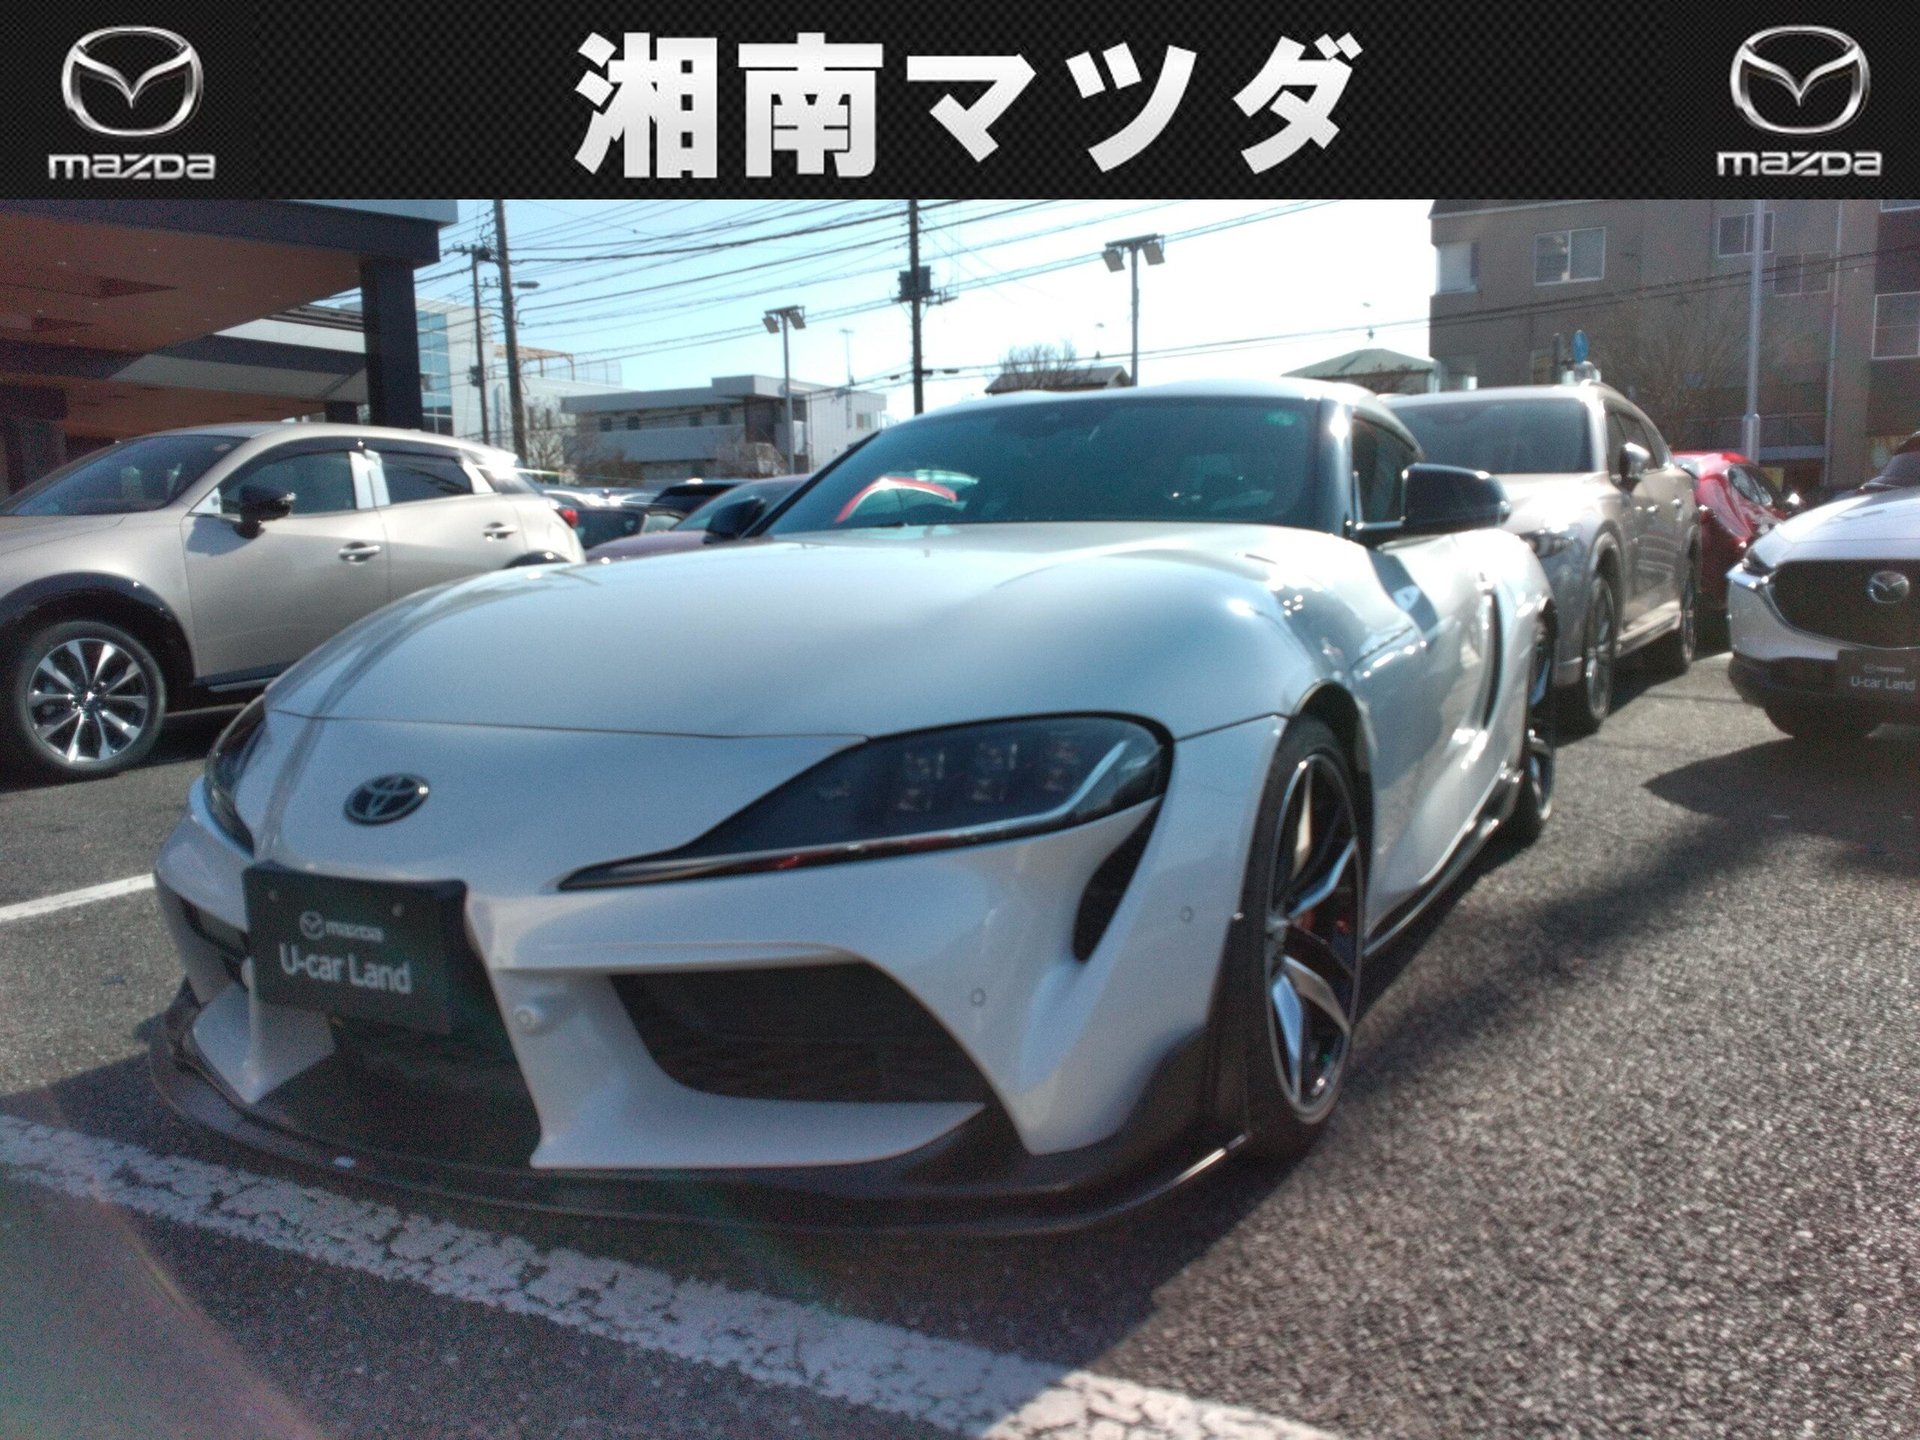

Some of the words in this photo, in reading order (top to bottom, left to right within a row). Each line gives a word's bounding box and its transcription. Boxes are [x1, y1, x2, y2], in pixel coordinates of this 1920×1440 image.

[1885, 676, 1916, 691] Land
[279, 942, 343, 984] U-car
[348, 952, 413, 994] Land
